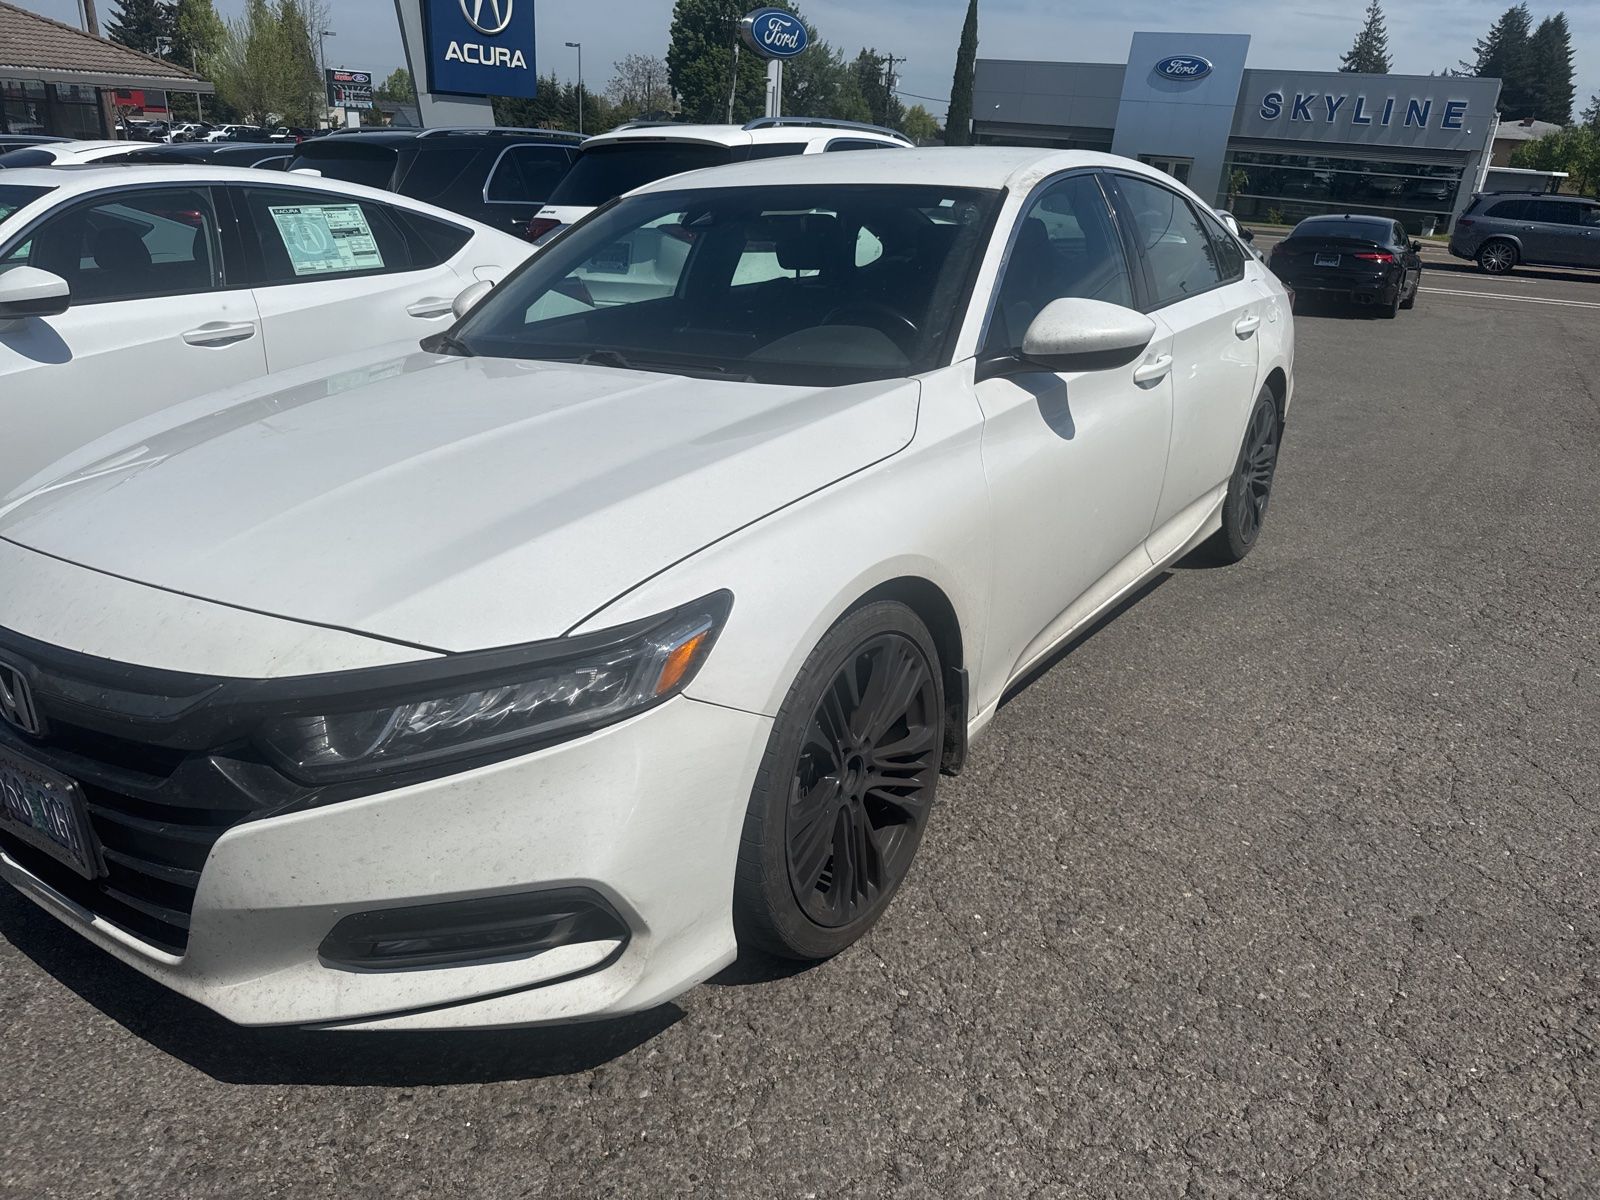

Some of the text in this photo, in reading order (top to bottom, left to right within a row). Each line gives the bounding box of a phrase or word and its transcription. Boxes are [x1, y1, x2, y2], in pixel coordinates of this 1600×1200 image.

[764, 18, 799, 48] Ford
[445, 41, 527, 69] ACURA
[1166, 60, 1199, 74] Ford
[1260, 92, 1468, 130] SKYLINE
